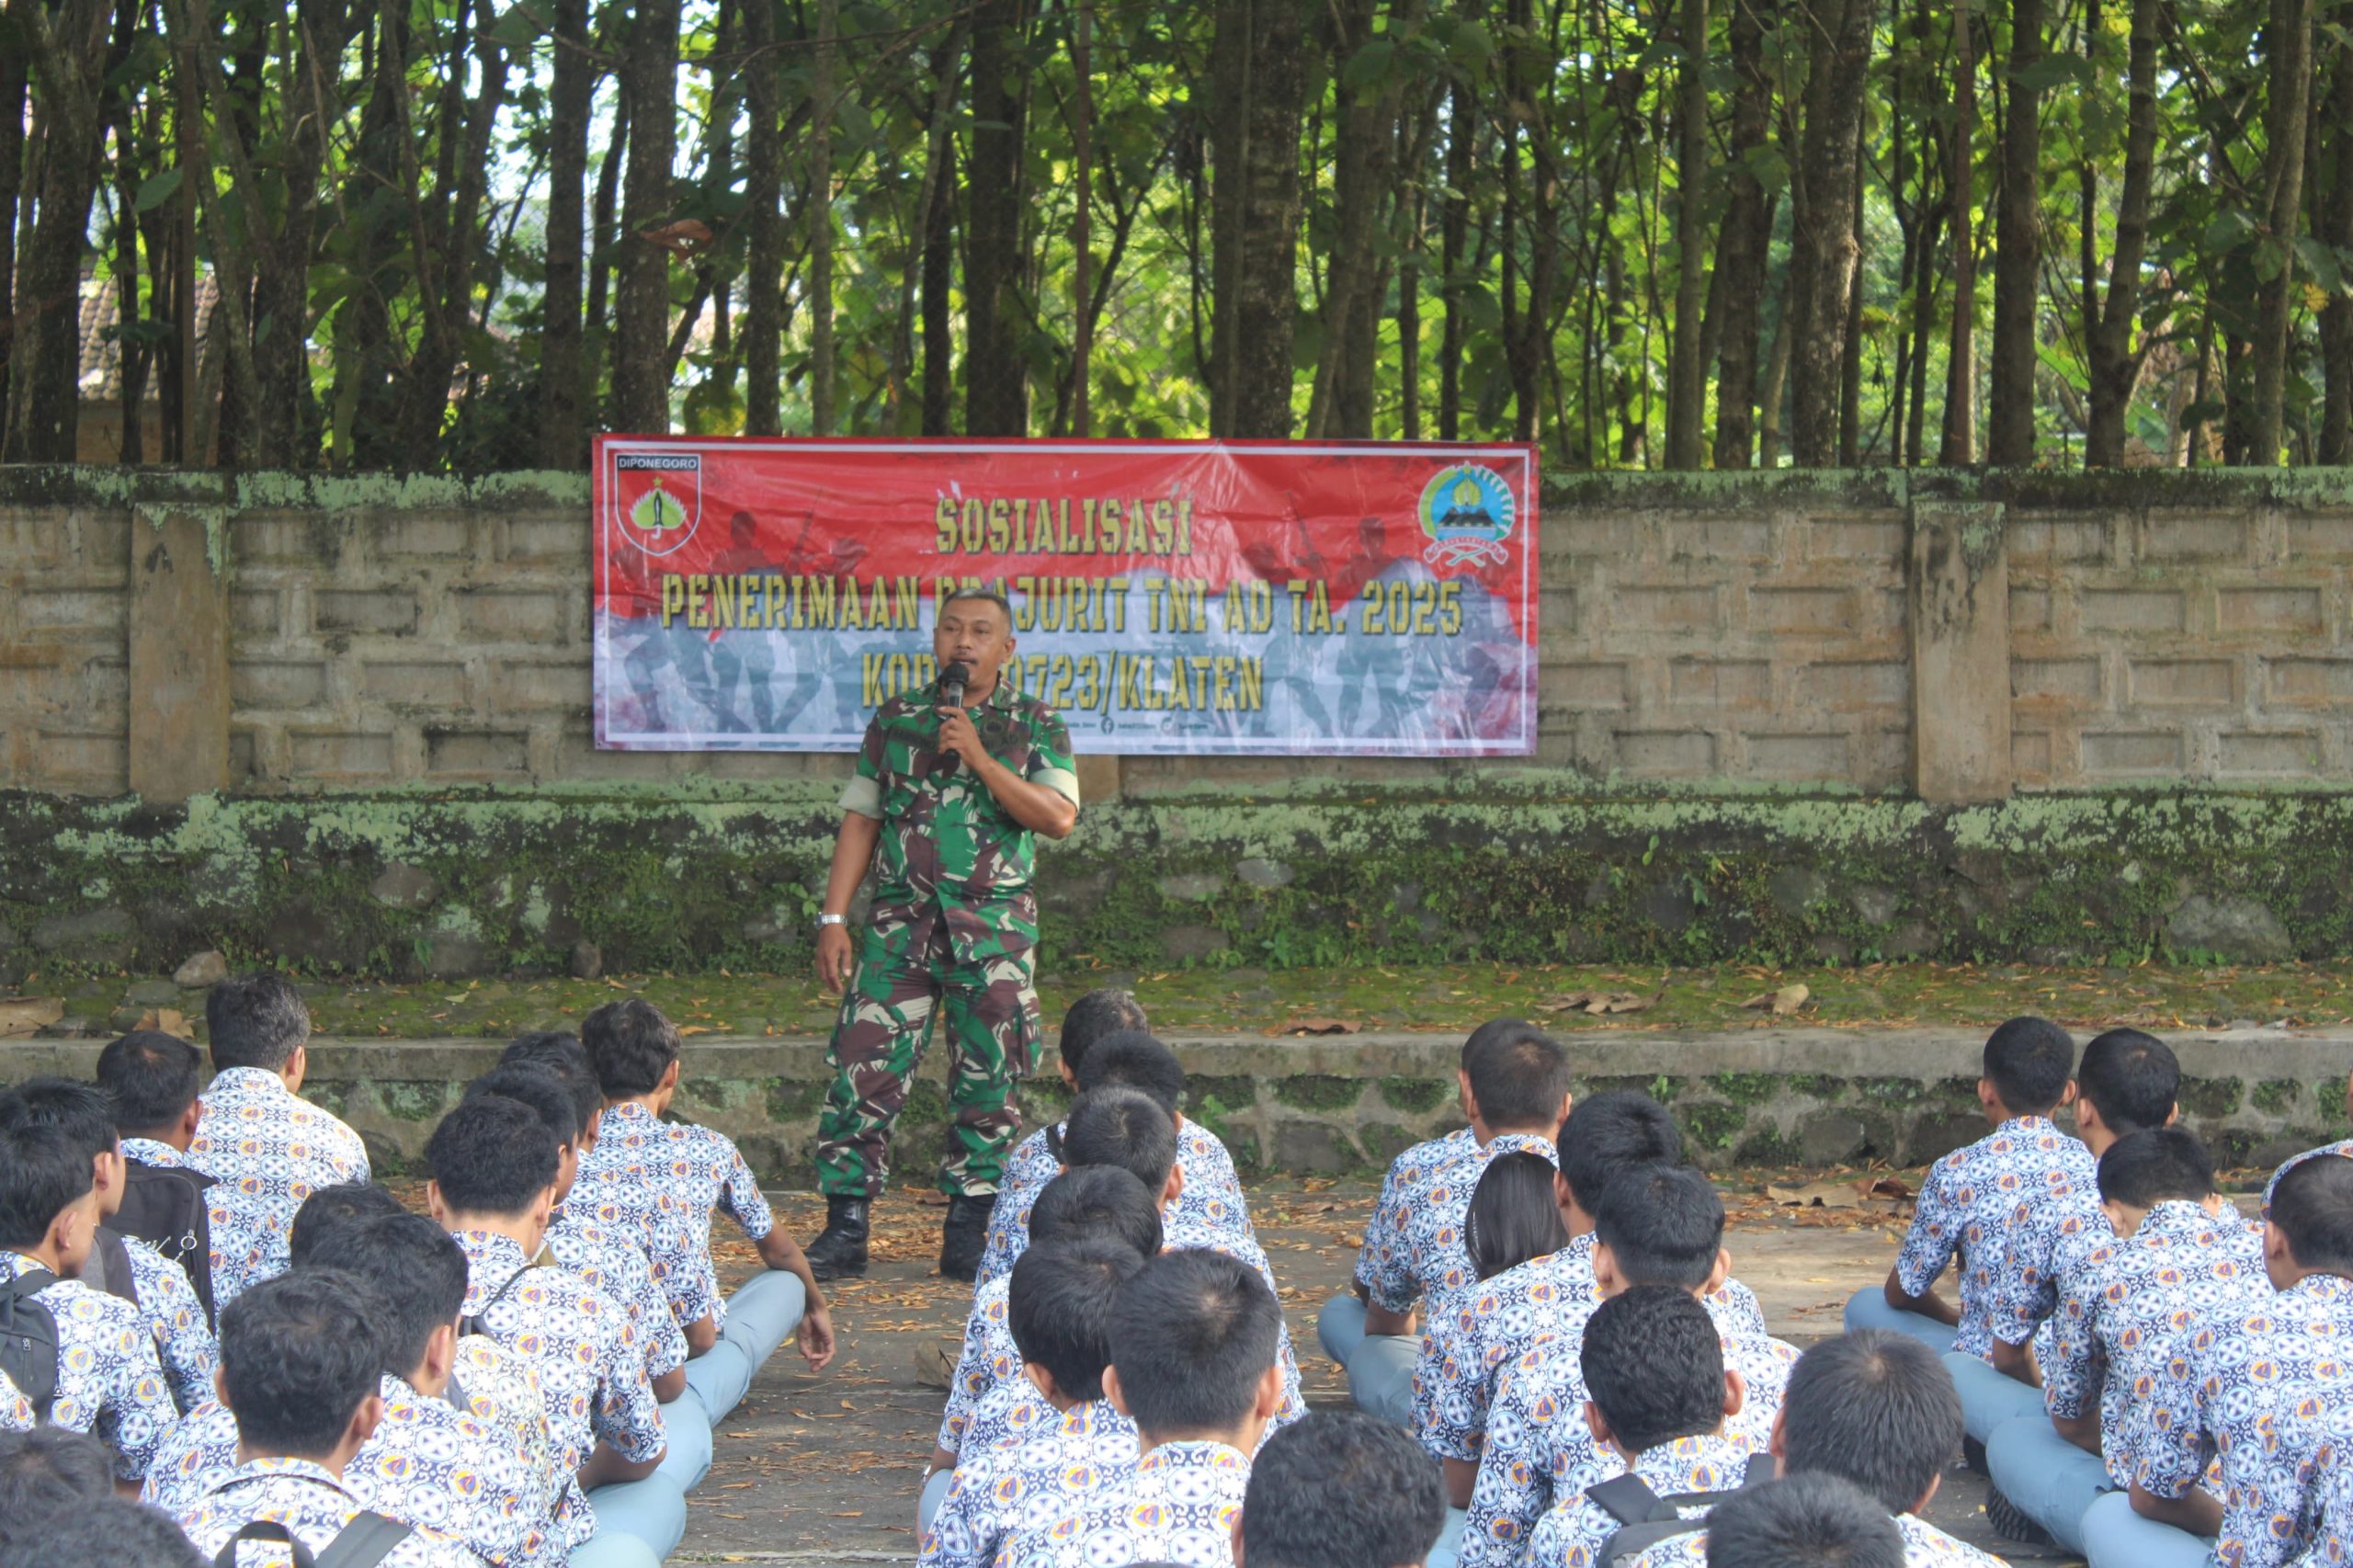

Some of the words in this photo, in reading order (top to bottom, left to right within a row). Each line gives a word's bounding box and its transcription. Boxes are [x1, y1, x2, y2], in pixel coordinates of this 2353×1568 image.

[619, 458, 697, 469] DIPONEGORO
[935, 497, 1192, 555] SOSIALISASI
[662, 574, 919, 631] PENERIMAAN
[935, 575, 1130, 633] JURIT
[1144, 578, 1209, 634] TNI
[1222, 579, 1273, 634] AD
[1287, 580, 1347, 635] TA.
[1361, 580, 1463, 636] 2025
[862, 653, 937, 708] KOD
